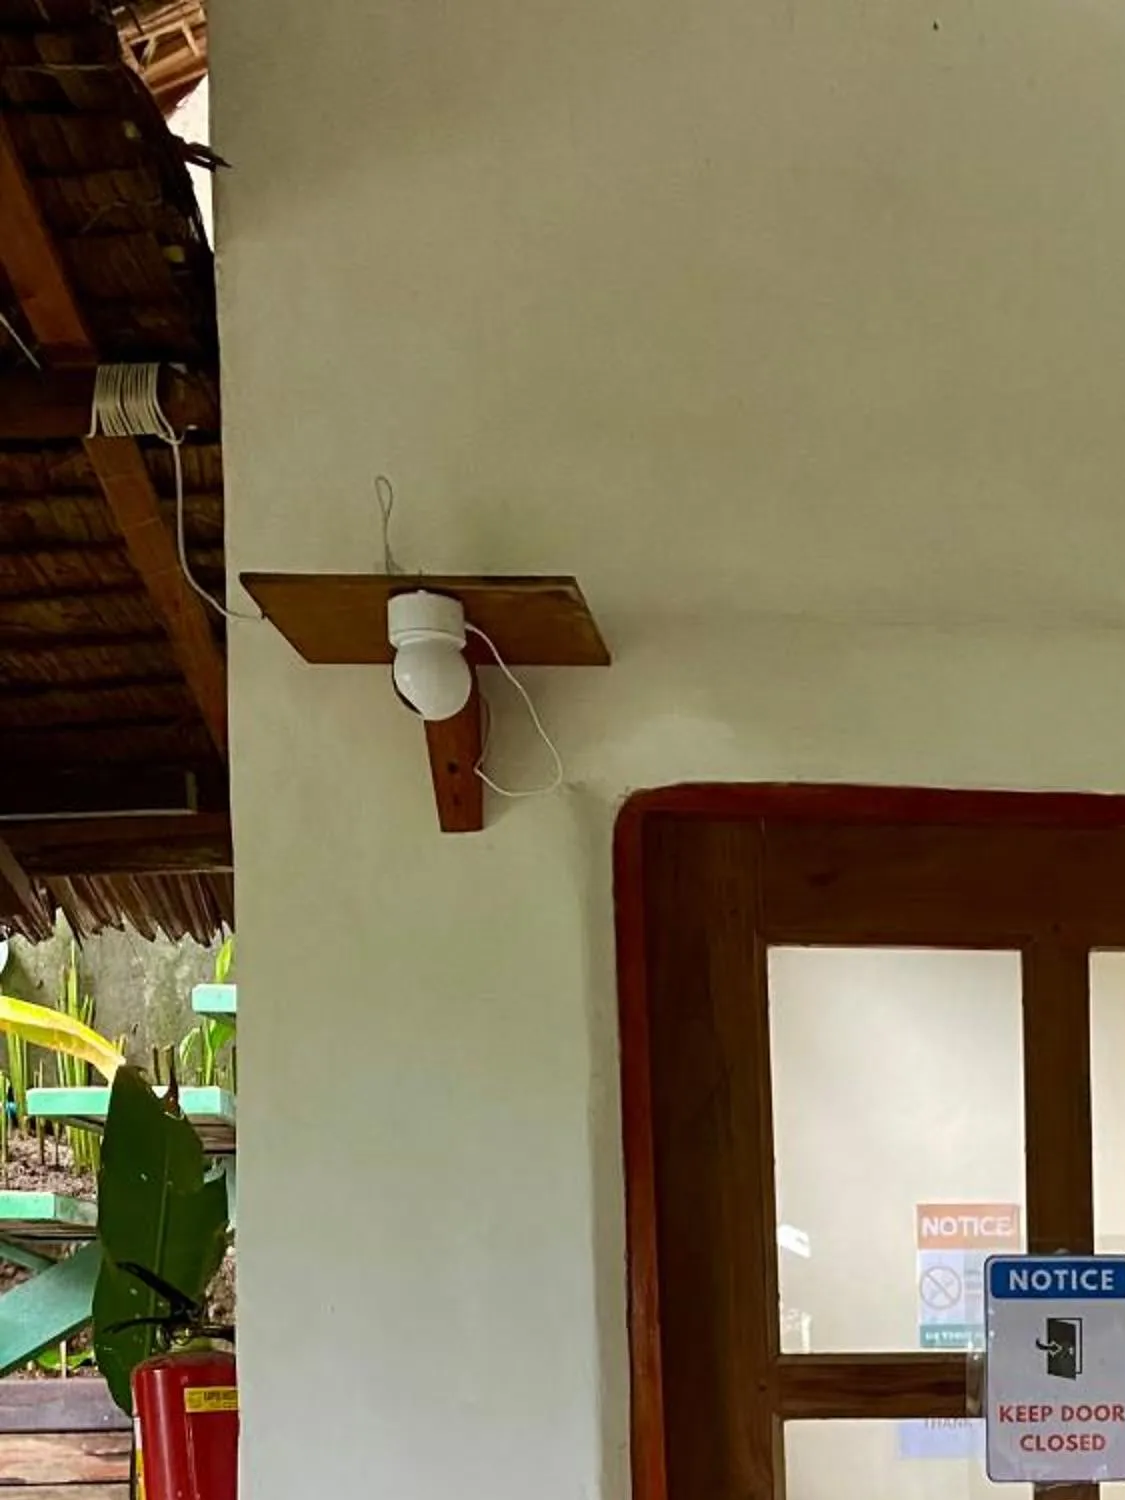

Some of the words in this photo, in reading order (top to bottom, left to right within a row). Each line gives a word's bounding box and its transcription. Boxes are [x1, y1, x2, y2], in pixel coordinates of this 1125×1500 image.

[921, 1216, 1013, 1237] NOTICE
[1008, 1269, 1115, 1291] NOTICE
[999, 1405, 1052, 1422] KEEP
[1061, 1405, 1125, 1422] DOOR
[1019, 1434, 1106, 1451] CLOSED
